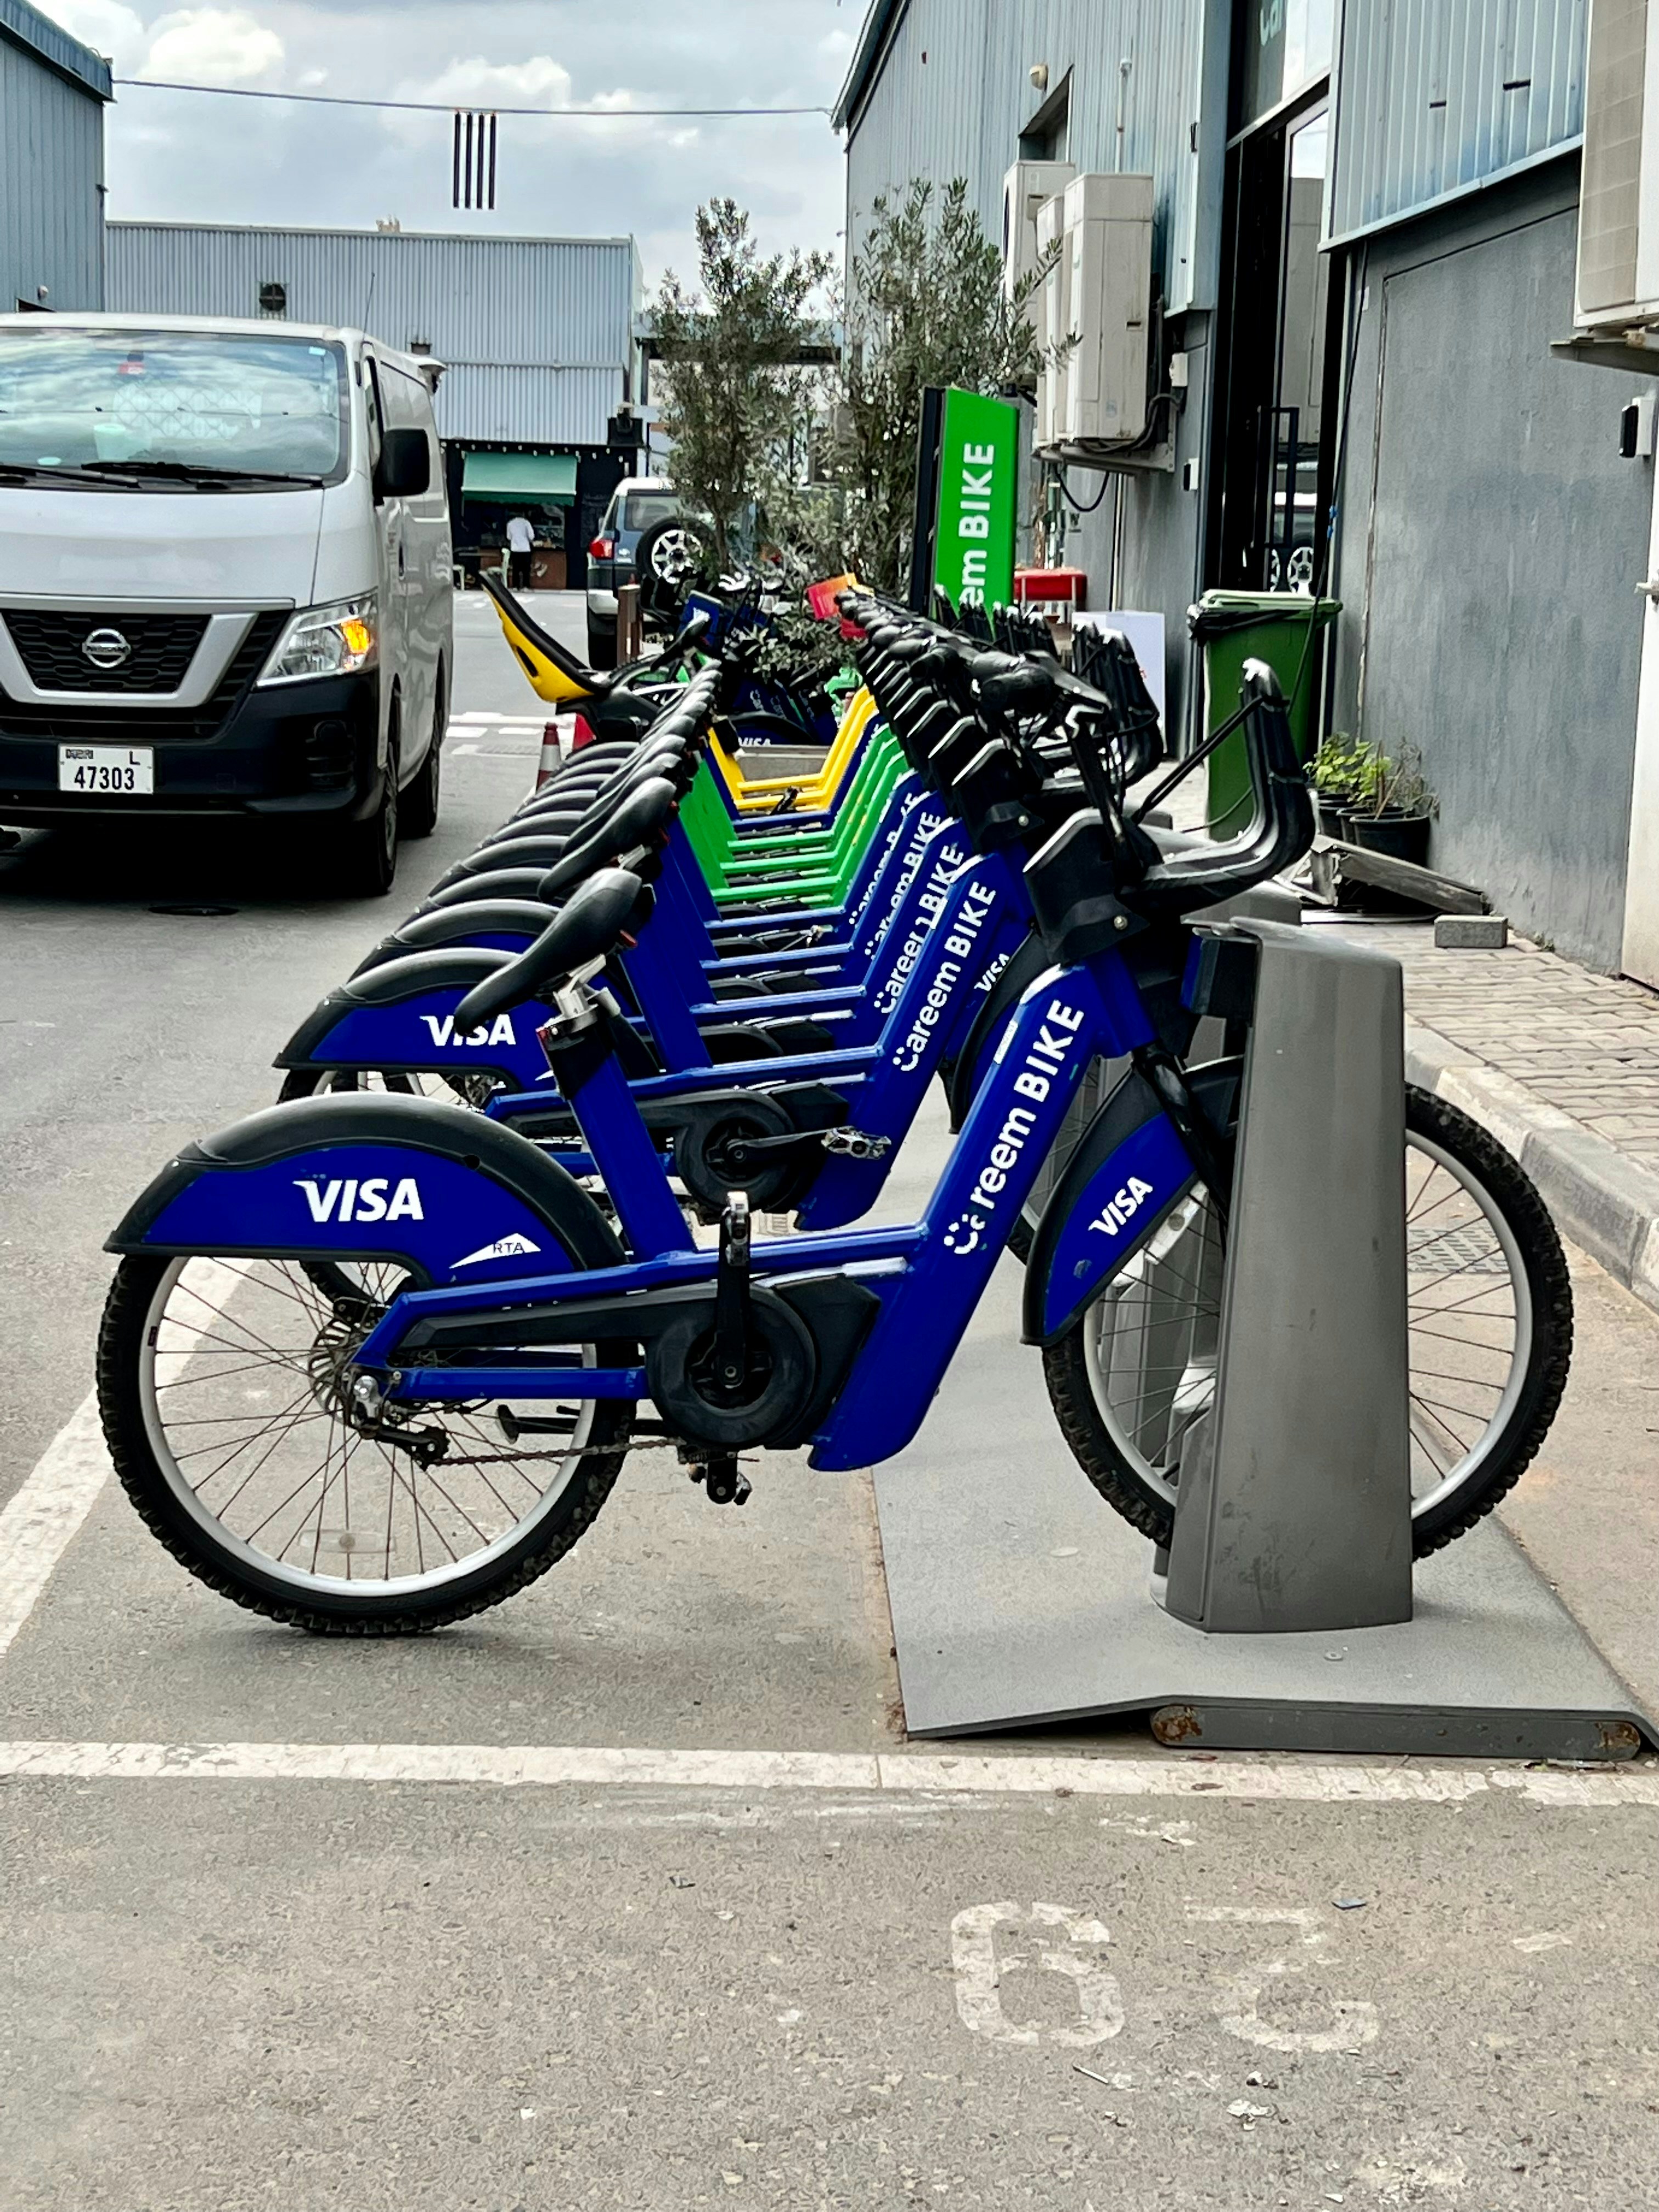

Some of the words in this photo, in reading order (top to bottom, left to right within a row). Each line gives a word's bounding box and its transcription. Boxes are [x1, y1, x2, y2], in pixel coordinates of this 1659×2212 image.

[958, 443, 995, 539] BIKE
[74, 766, 134, 790] 47303
[129, 751, 140, 765] L
[919, 845, 964, 914] BIKE
[893, 961, 962, 1071] Careem
[944, 882, 997, 958] BIKE
[974, 953, 1010, 992] VISA
[1013, 1000, 1085, 1103] BIKE
[292, 1178, 424, 1222] VISA
[1088, 1177, 1153, 1236] VISA
[493, 1242, 525, 1254] RTA
